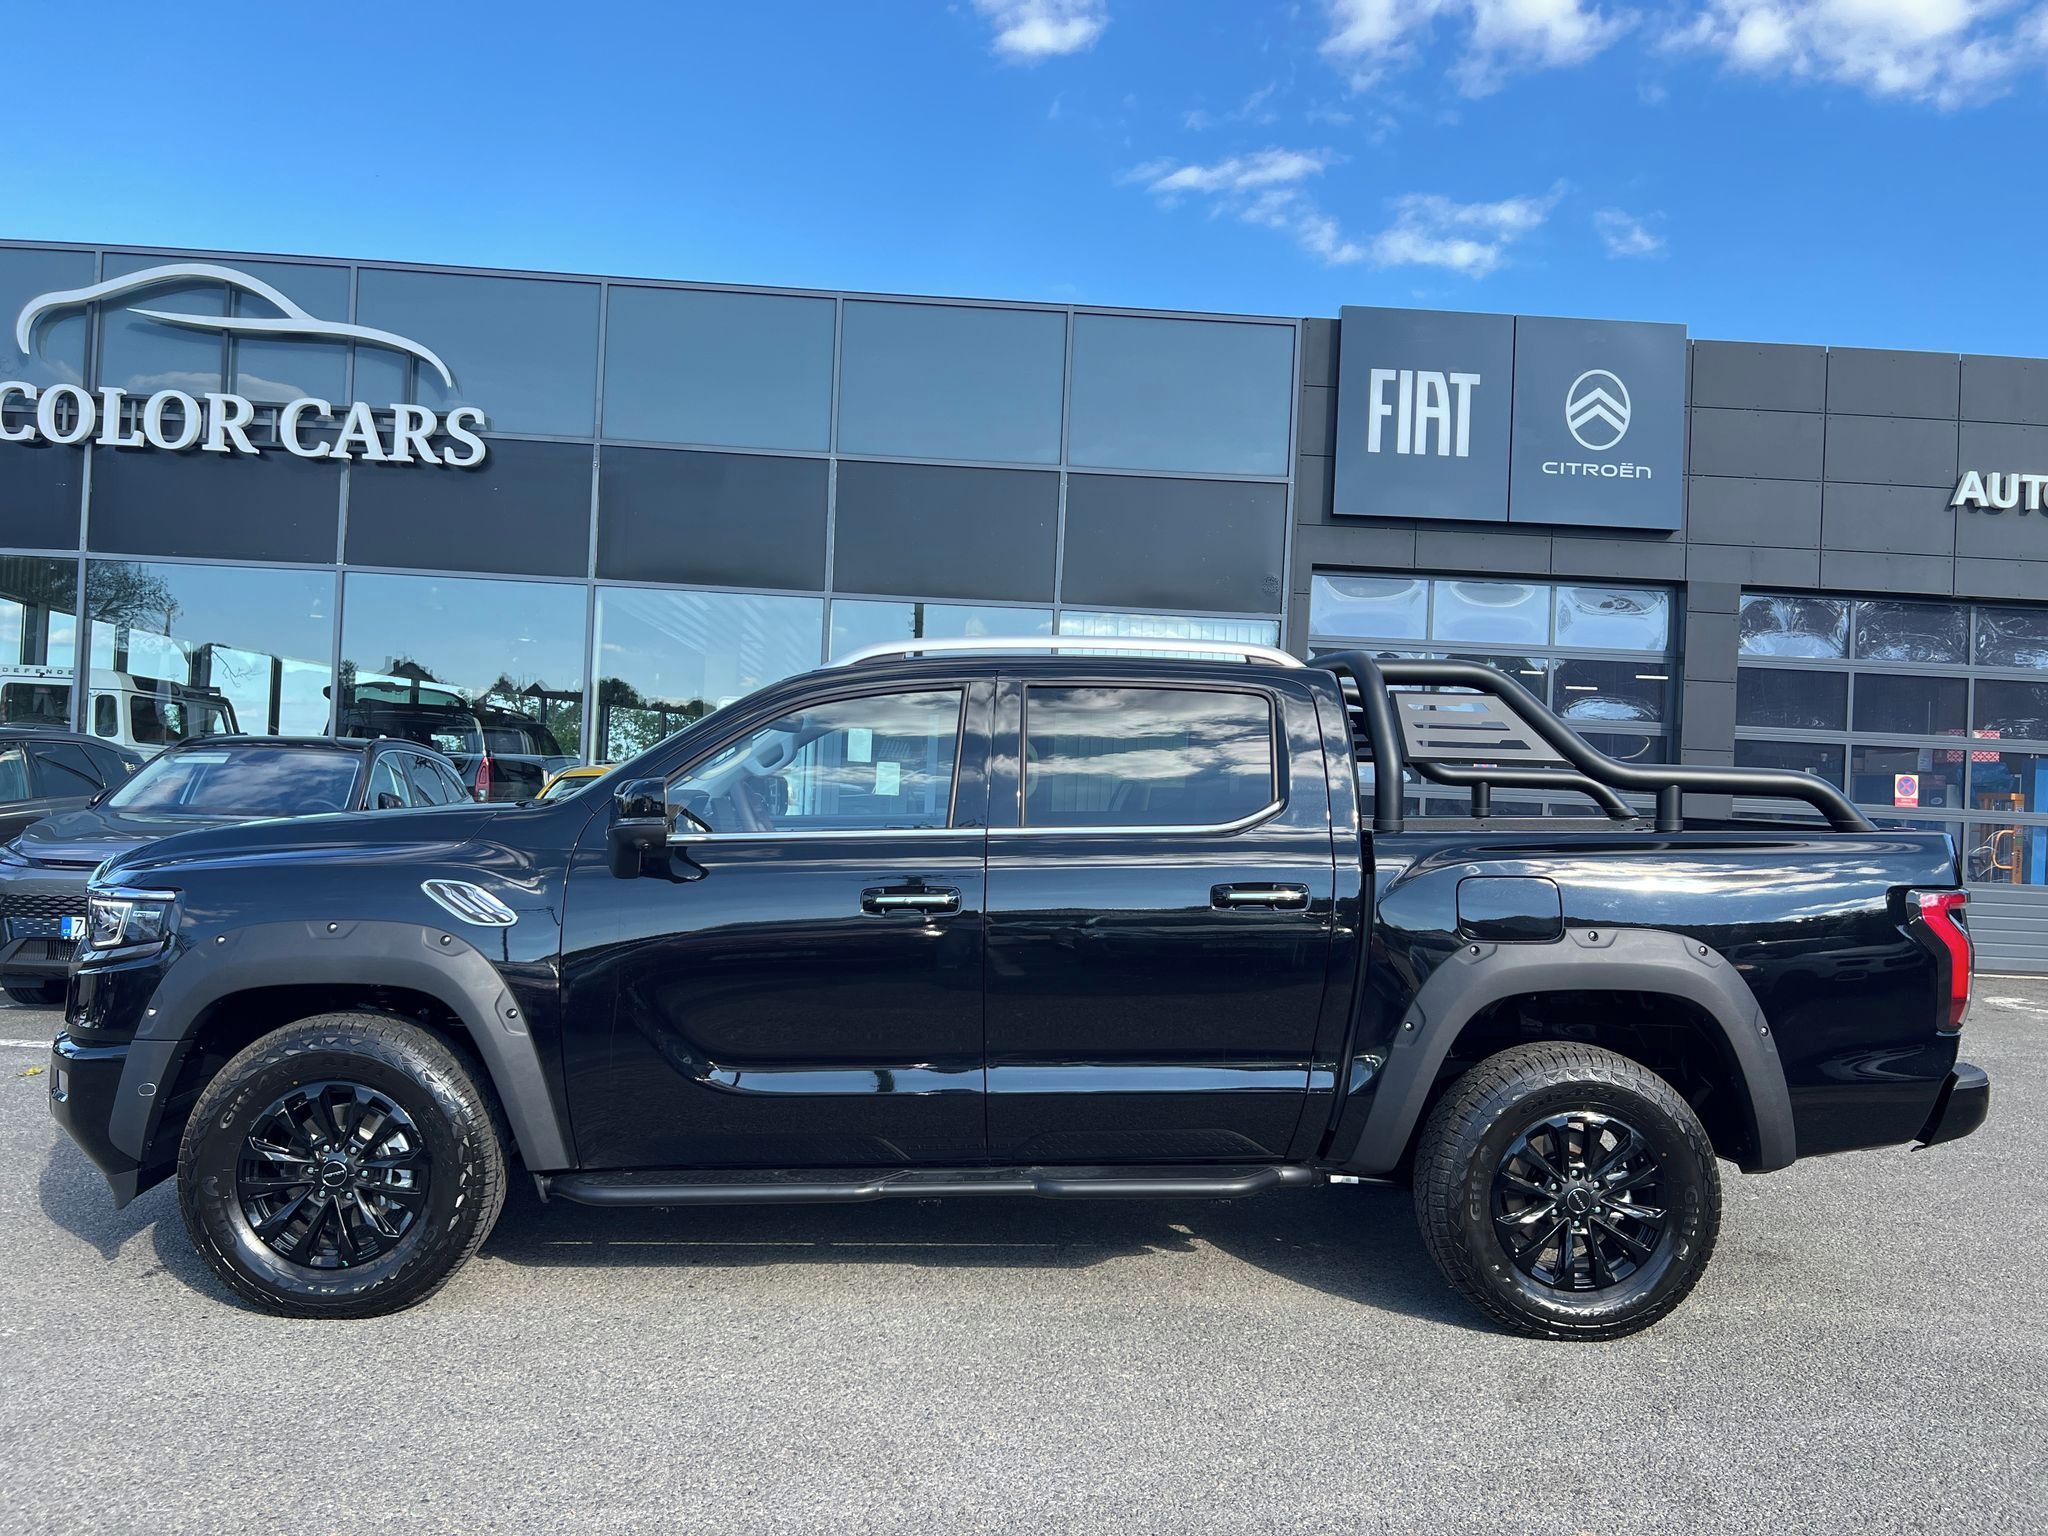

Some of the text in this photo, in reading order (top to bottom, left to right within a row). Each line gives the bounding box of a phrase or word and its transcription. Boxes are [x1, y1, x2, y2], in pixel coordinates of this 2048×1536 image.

[0, 380, 486, 467] COLOR CARS
[1367, 368, 1481, 457] FIAT
[1950, 470, 2048, 511] AUT
[2, 667, 75, 676] DEFENDE
